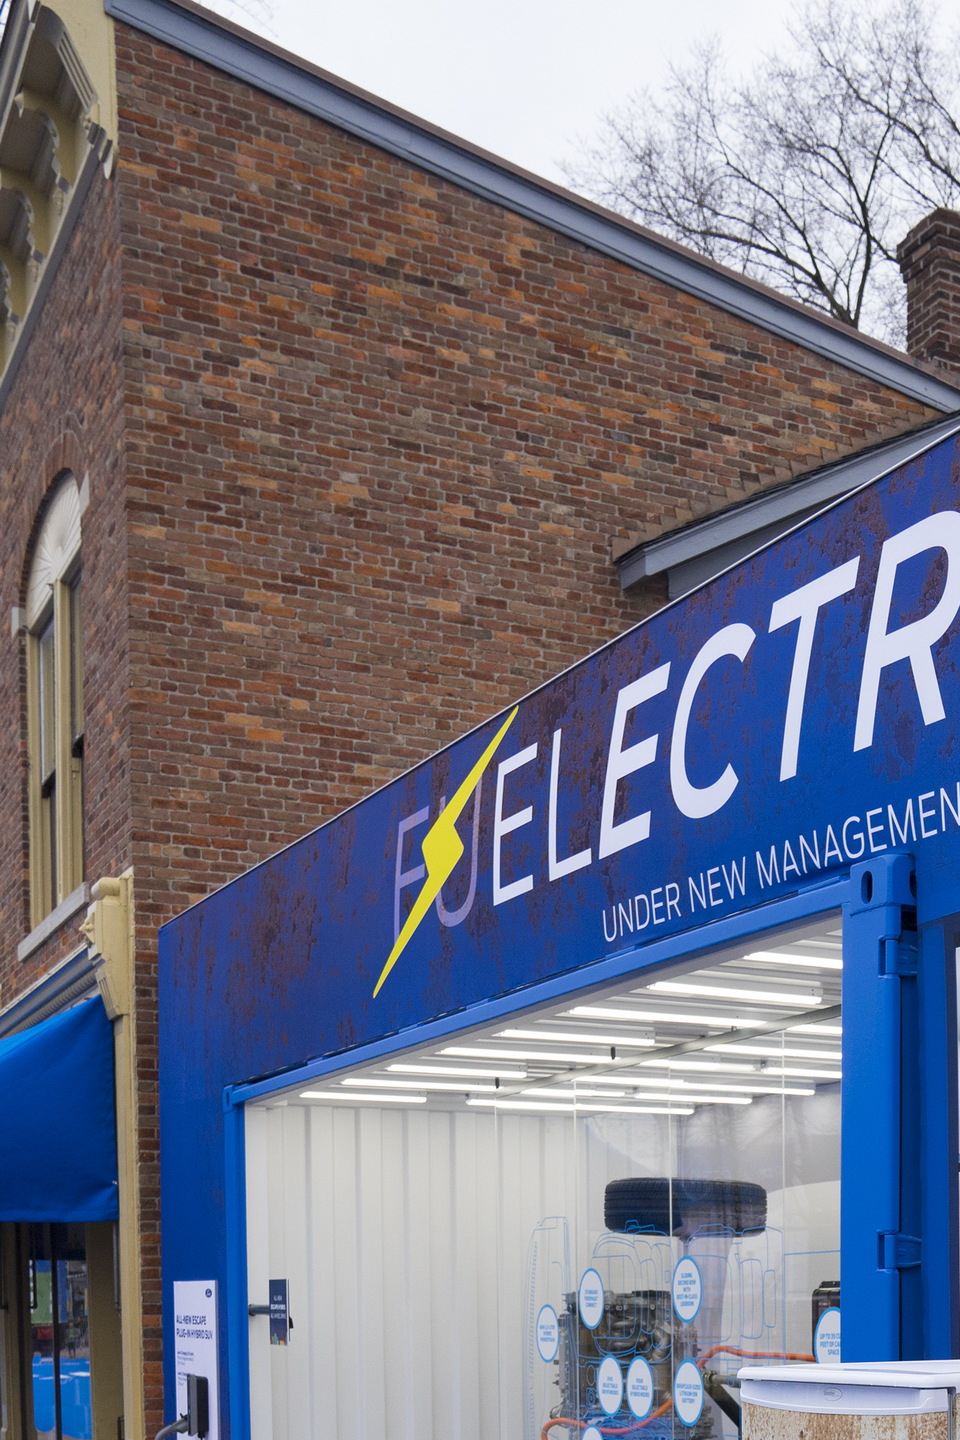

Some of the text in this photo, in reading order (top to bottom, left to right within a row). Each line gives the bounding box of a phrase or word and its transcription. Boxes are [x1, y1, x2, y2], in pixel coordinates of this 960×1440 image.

[602, 882, 682, 942] UNDER
[688, 855, 747, 913] NEW
[192, 1315, 207, 1326] ESCAPE
[191, 1329, 204, 1339] HYBRID
